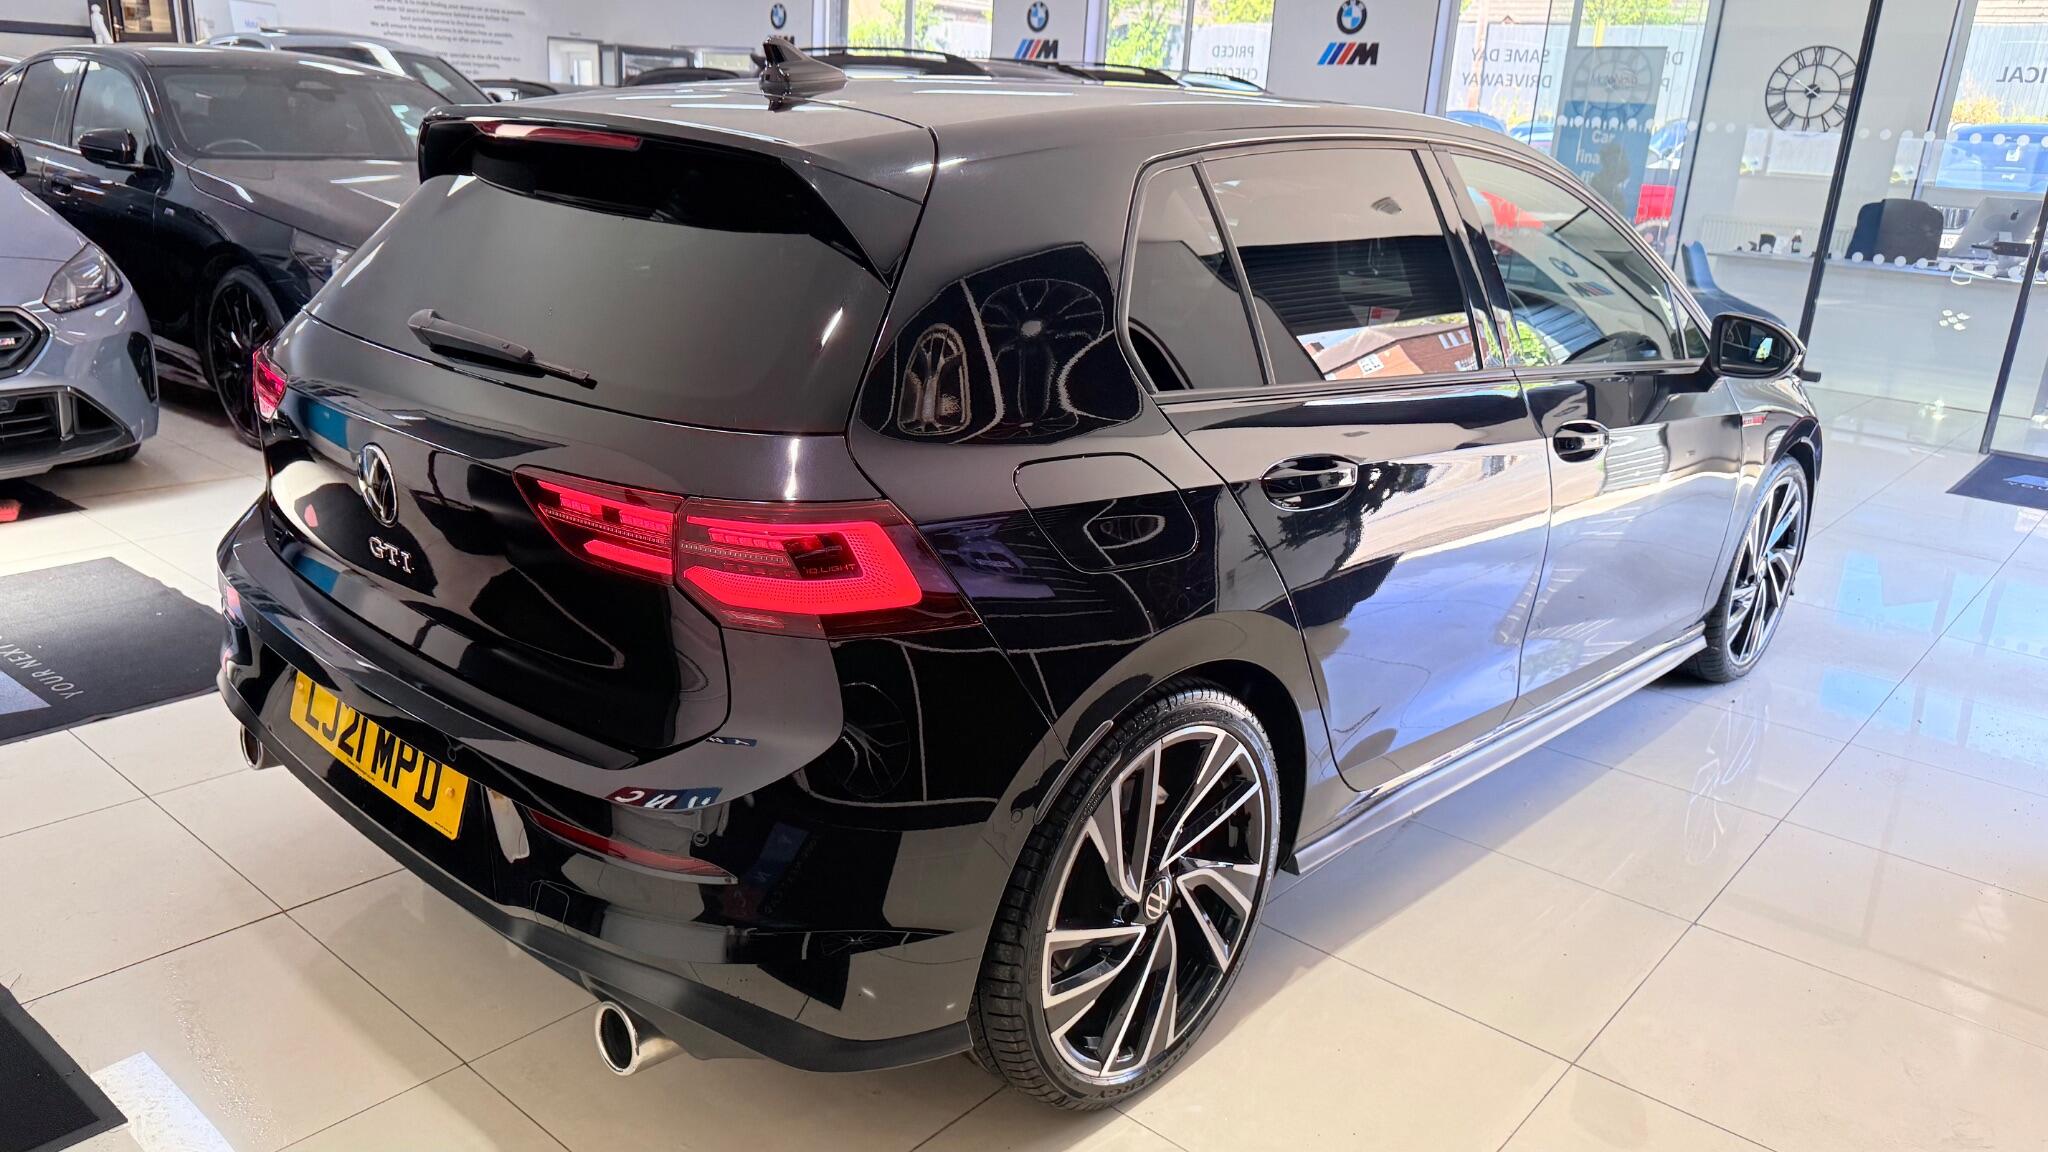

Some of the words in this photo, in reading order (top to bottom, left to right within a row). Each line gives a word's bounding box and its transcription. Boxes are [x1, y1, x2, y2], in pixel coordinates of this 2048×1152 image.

[1591, 129, 1616, 144] Car
[368, 536, 415, 574] GTI
[31, 668, 84, 700] YOUR
[305, 681, 370, 764] LJ21
[370, 724, 443, 812] MPD
